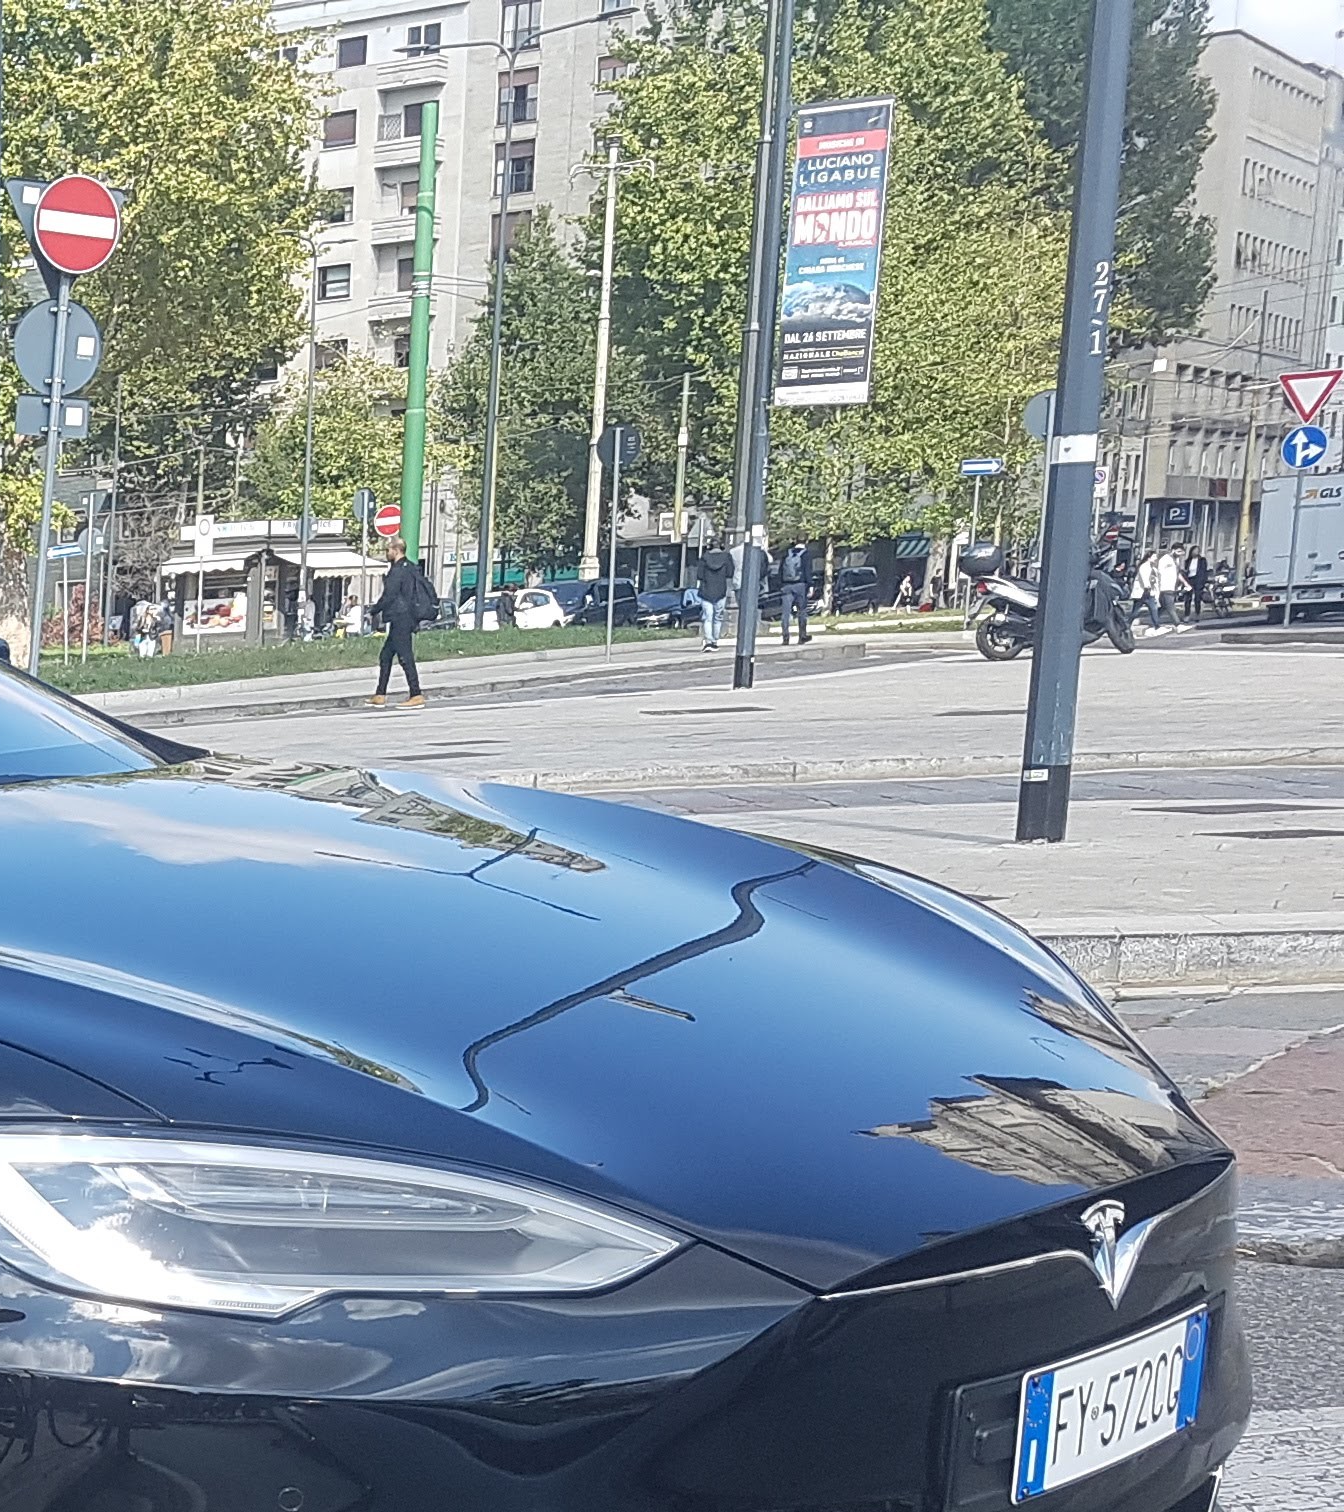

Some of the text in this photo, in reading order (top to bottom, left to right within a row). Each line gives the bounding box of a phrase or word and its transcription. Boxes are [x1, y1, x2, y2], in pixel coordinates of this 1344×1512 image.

[807, 153, 874, 171] LUCIANO
[799, 166, 881, 185] LIGABUE
[796, 192, 854, 212] BALLIAMO
[793, 209, 877, 245] MONDO
[784, 328, 867, 344] DAL 26 SETTEMBRE
[1319, 486, 1343, 499] GLS
